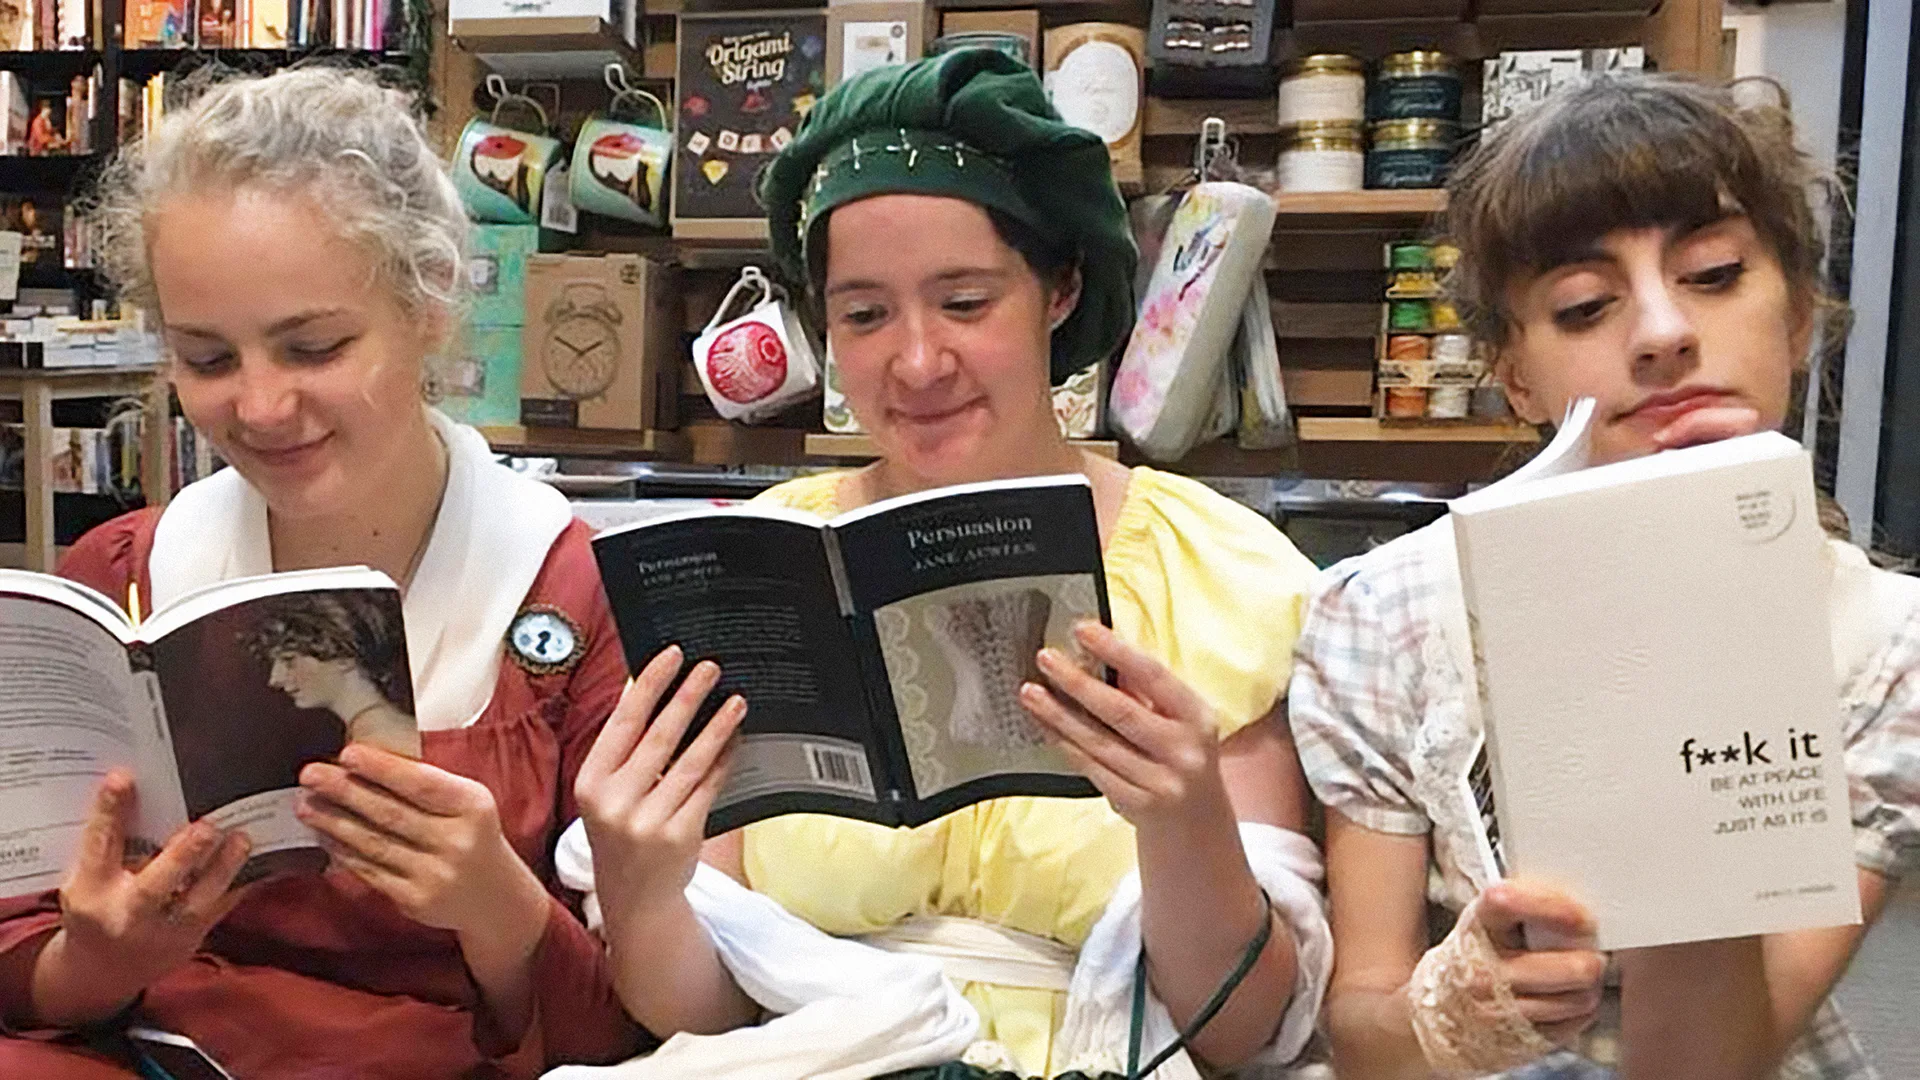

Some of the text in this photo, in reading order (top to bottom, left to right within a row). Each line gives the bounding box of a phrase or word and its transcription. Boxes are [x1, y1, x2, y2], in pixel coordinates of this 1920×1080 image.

[706, 31, 793, 65] Origami
[721, 57, 785, 84] String
[907, 515, 1033, 549] Persuasion
[1788, 727, 1822, 760] it
[1710, 765, 1823, 792] BE AT PEACE
[1738, 786, 1825, 808] WITH LIFE
[1714, 816, 1756, 834] JUST
[1762, 813, 1787, 828] AS
[1791, 811, 1805, 825] IT
